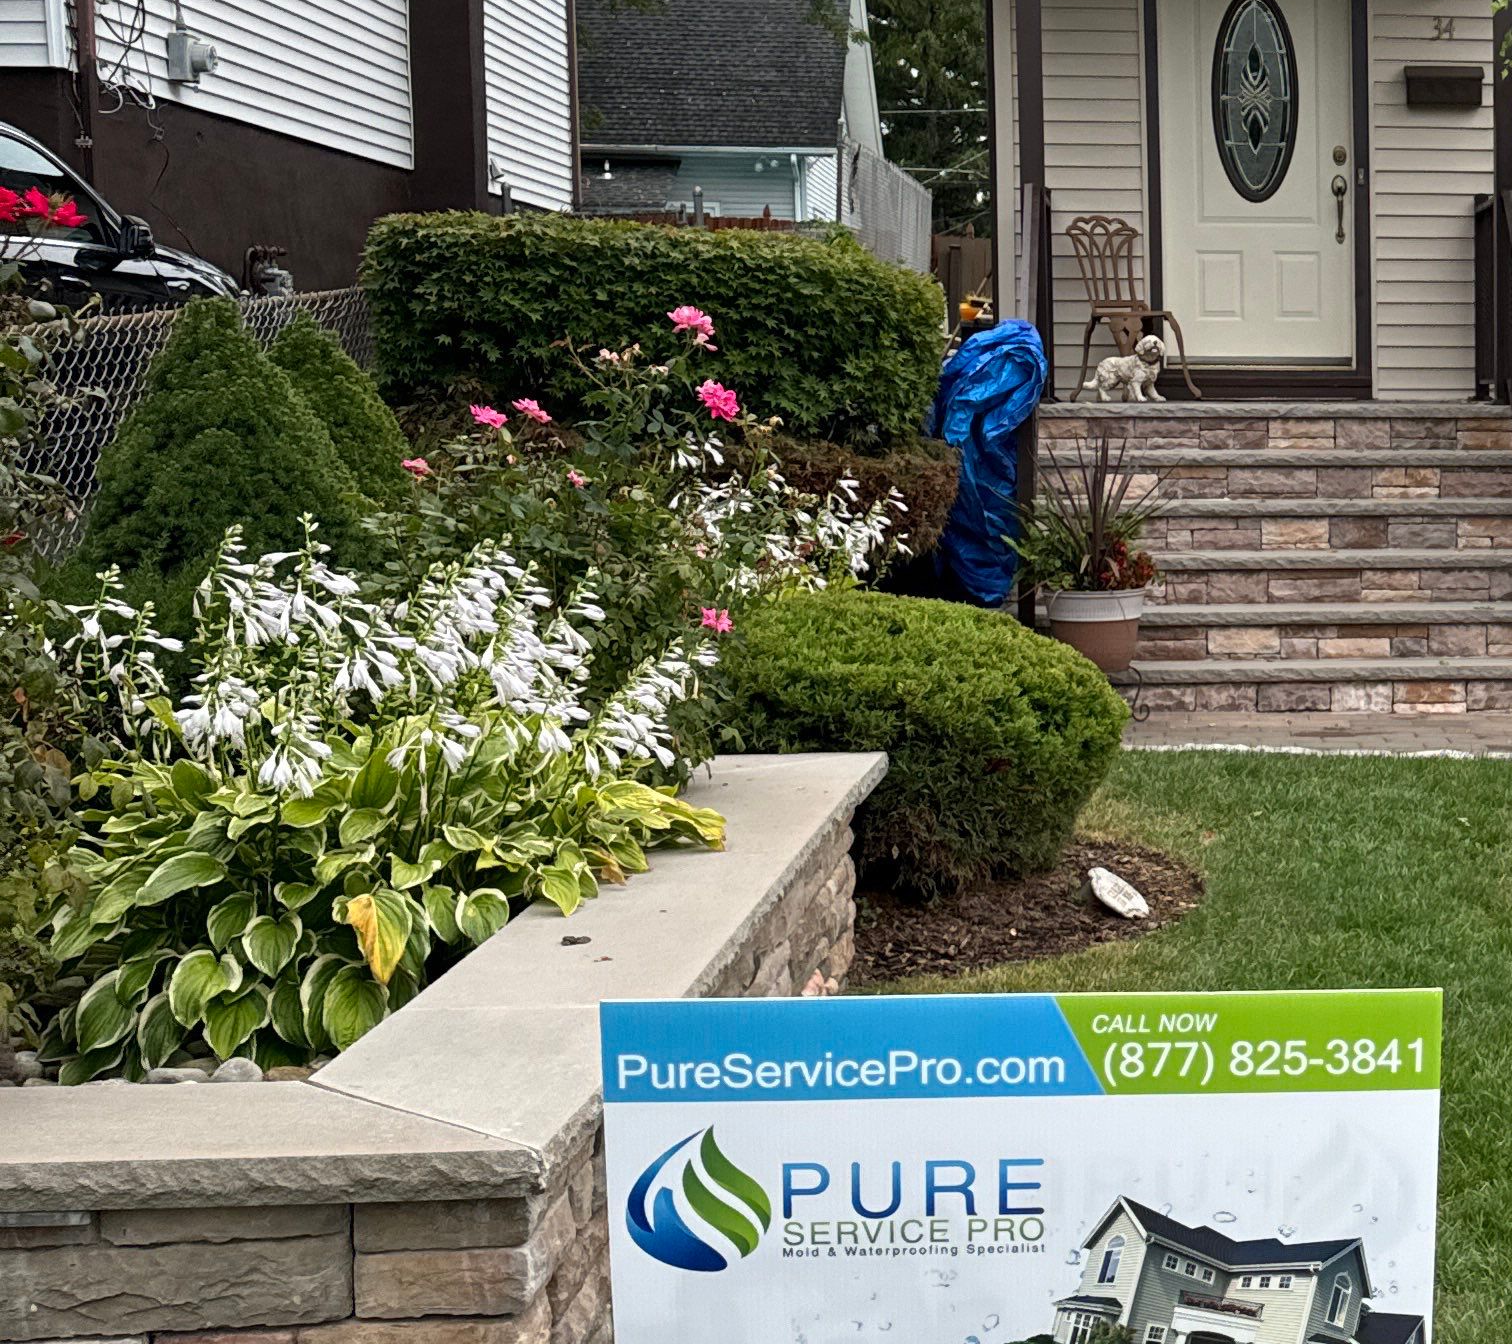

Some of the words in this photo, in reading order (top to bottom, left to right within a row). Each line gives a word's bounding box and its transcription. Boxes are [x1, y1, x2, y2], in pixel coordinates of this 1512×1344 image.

[1091, 1013, 1152, 1036] CALL
[1158, 1012, 1218, 1033] NOW
[616, 1049, 1066, 1091] PureServicePro.com
[1102, 1040, 1216, 1088] (877)
[1230, 1037, 1426, 1079] 825-3841
[782, 1158, 1045, 1219] PURE
[782, 1219, 950, 1246] SERVICE
[967, 1217, 1044, 1242] PRO
[782, 1246, 820, 1258] Mold
[828, 1246, 837, 1257] &
[845, 1244, 959, 1257] Waterproofing
[966, 1243, 1045, 1255] Specialist
